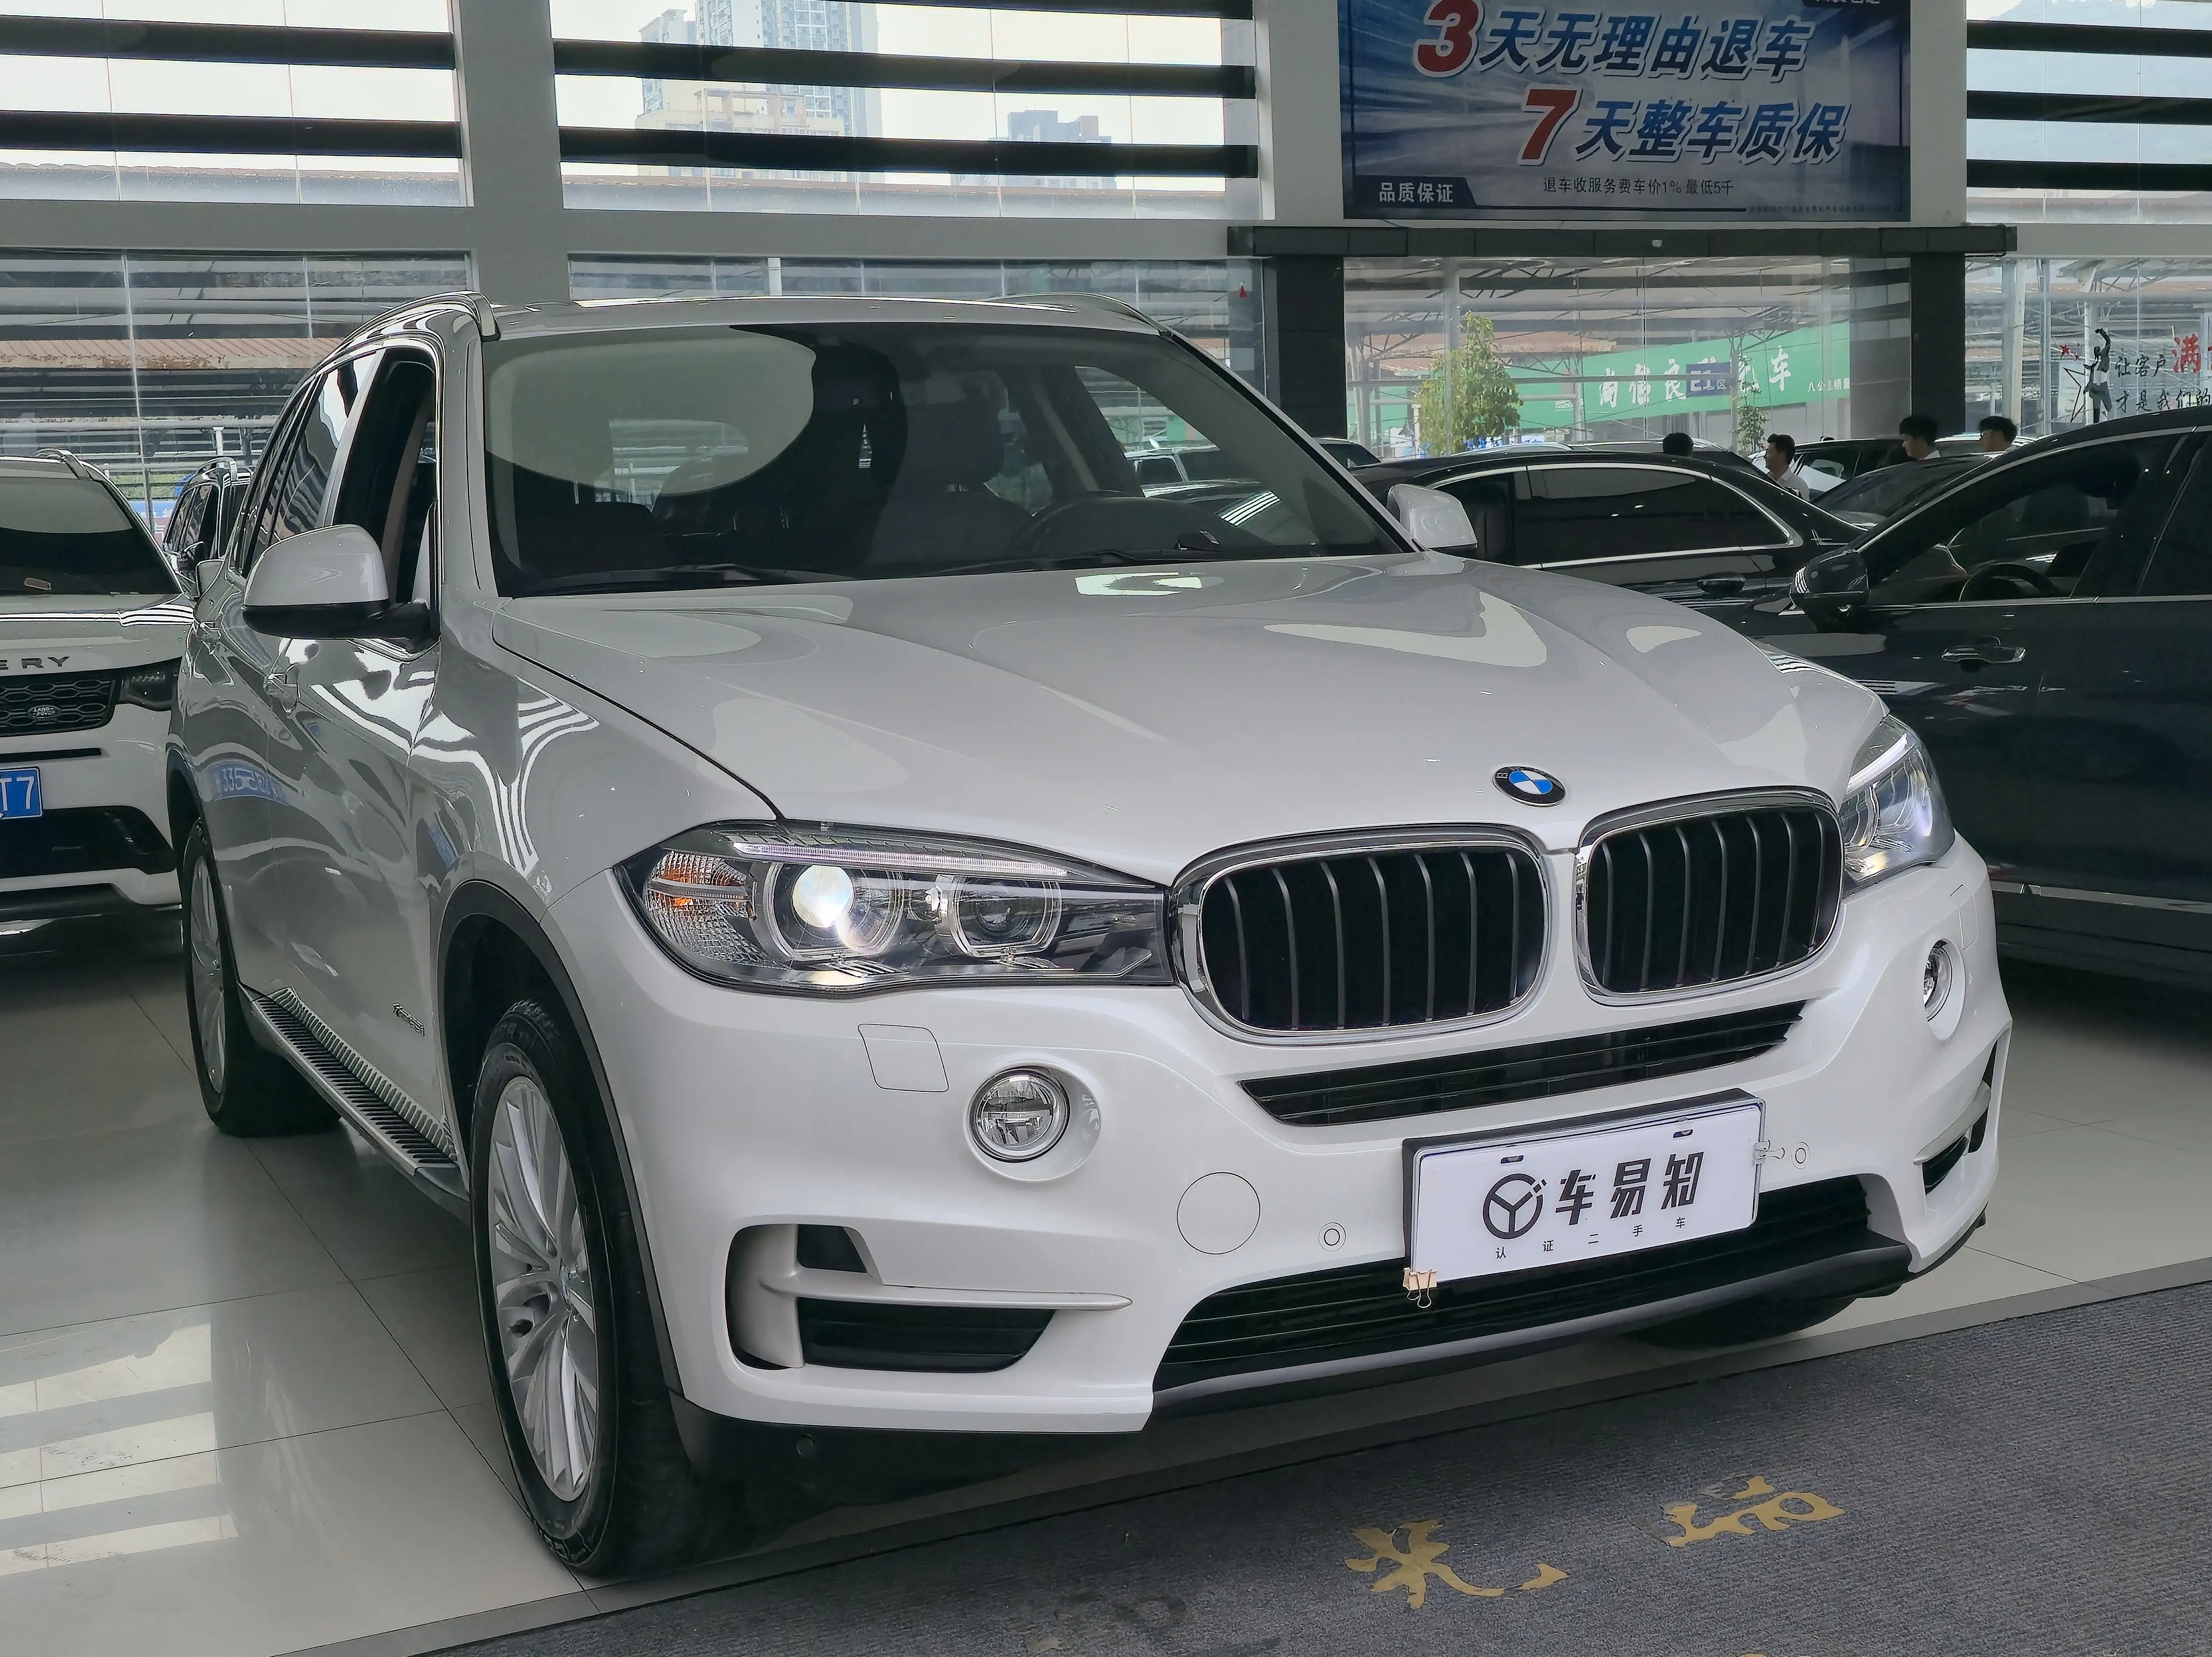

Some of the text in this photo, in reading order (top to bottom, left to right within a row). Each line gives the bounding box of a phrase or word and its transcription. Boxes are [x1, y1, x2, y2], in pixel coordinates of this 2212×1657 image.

[1415, 0, 1814, 78] 3天无理由退车
[1520, 88, 1846, 162] 7天整车质保
[1379, 182, 1453, 203] 品质保证
[2115, 333, 2212, 378] 让客户满
[1555, 1152, 1704, 1226] 车易知
[1495, 1216, 1685, 1259] 认证二手车
